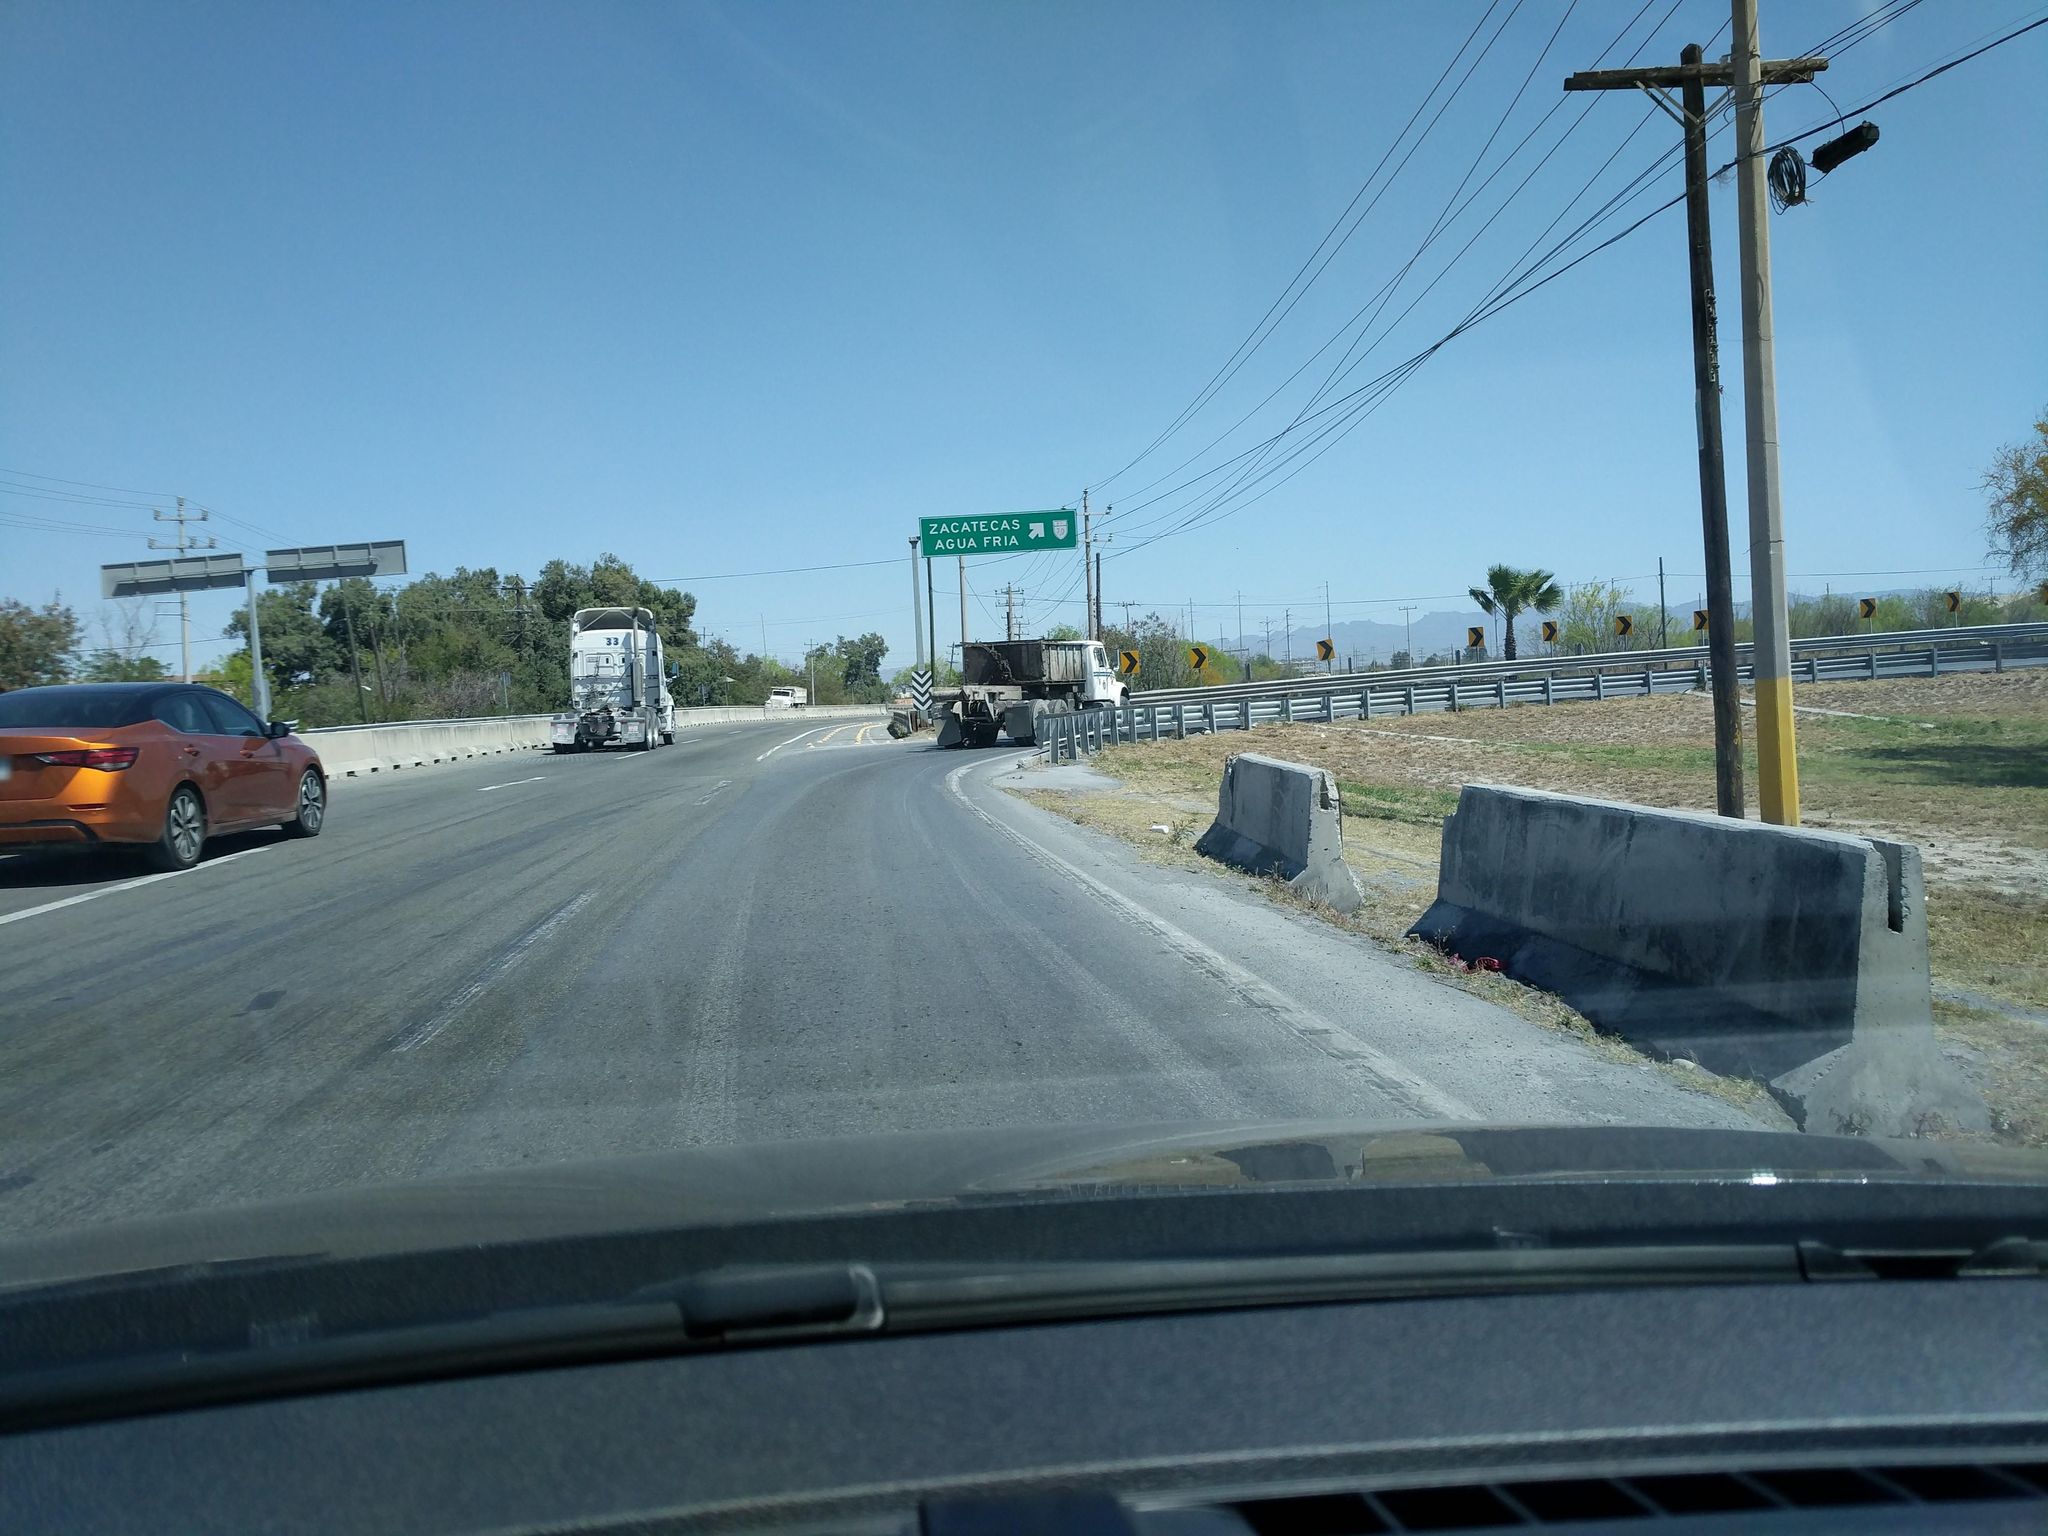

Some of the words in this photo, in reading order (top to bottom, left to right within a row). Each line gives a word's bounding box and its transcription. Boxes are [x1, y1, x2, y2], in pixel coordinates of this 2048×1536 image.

[929, 519, 1020, 535] ZACATECAS
[934, 538, 977, 551] AGUA
[983, 535, 1019, 548] FRIA
[606, 637, 619, 646] 33
